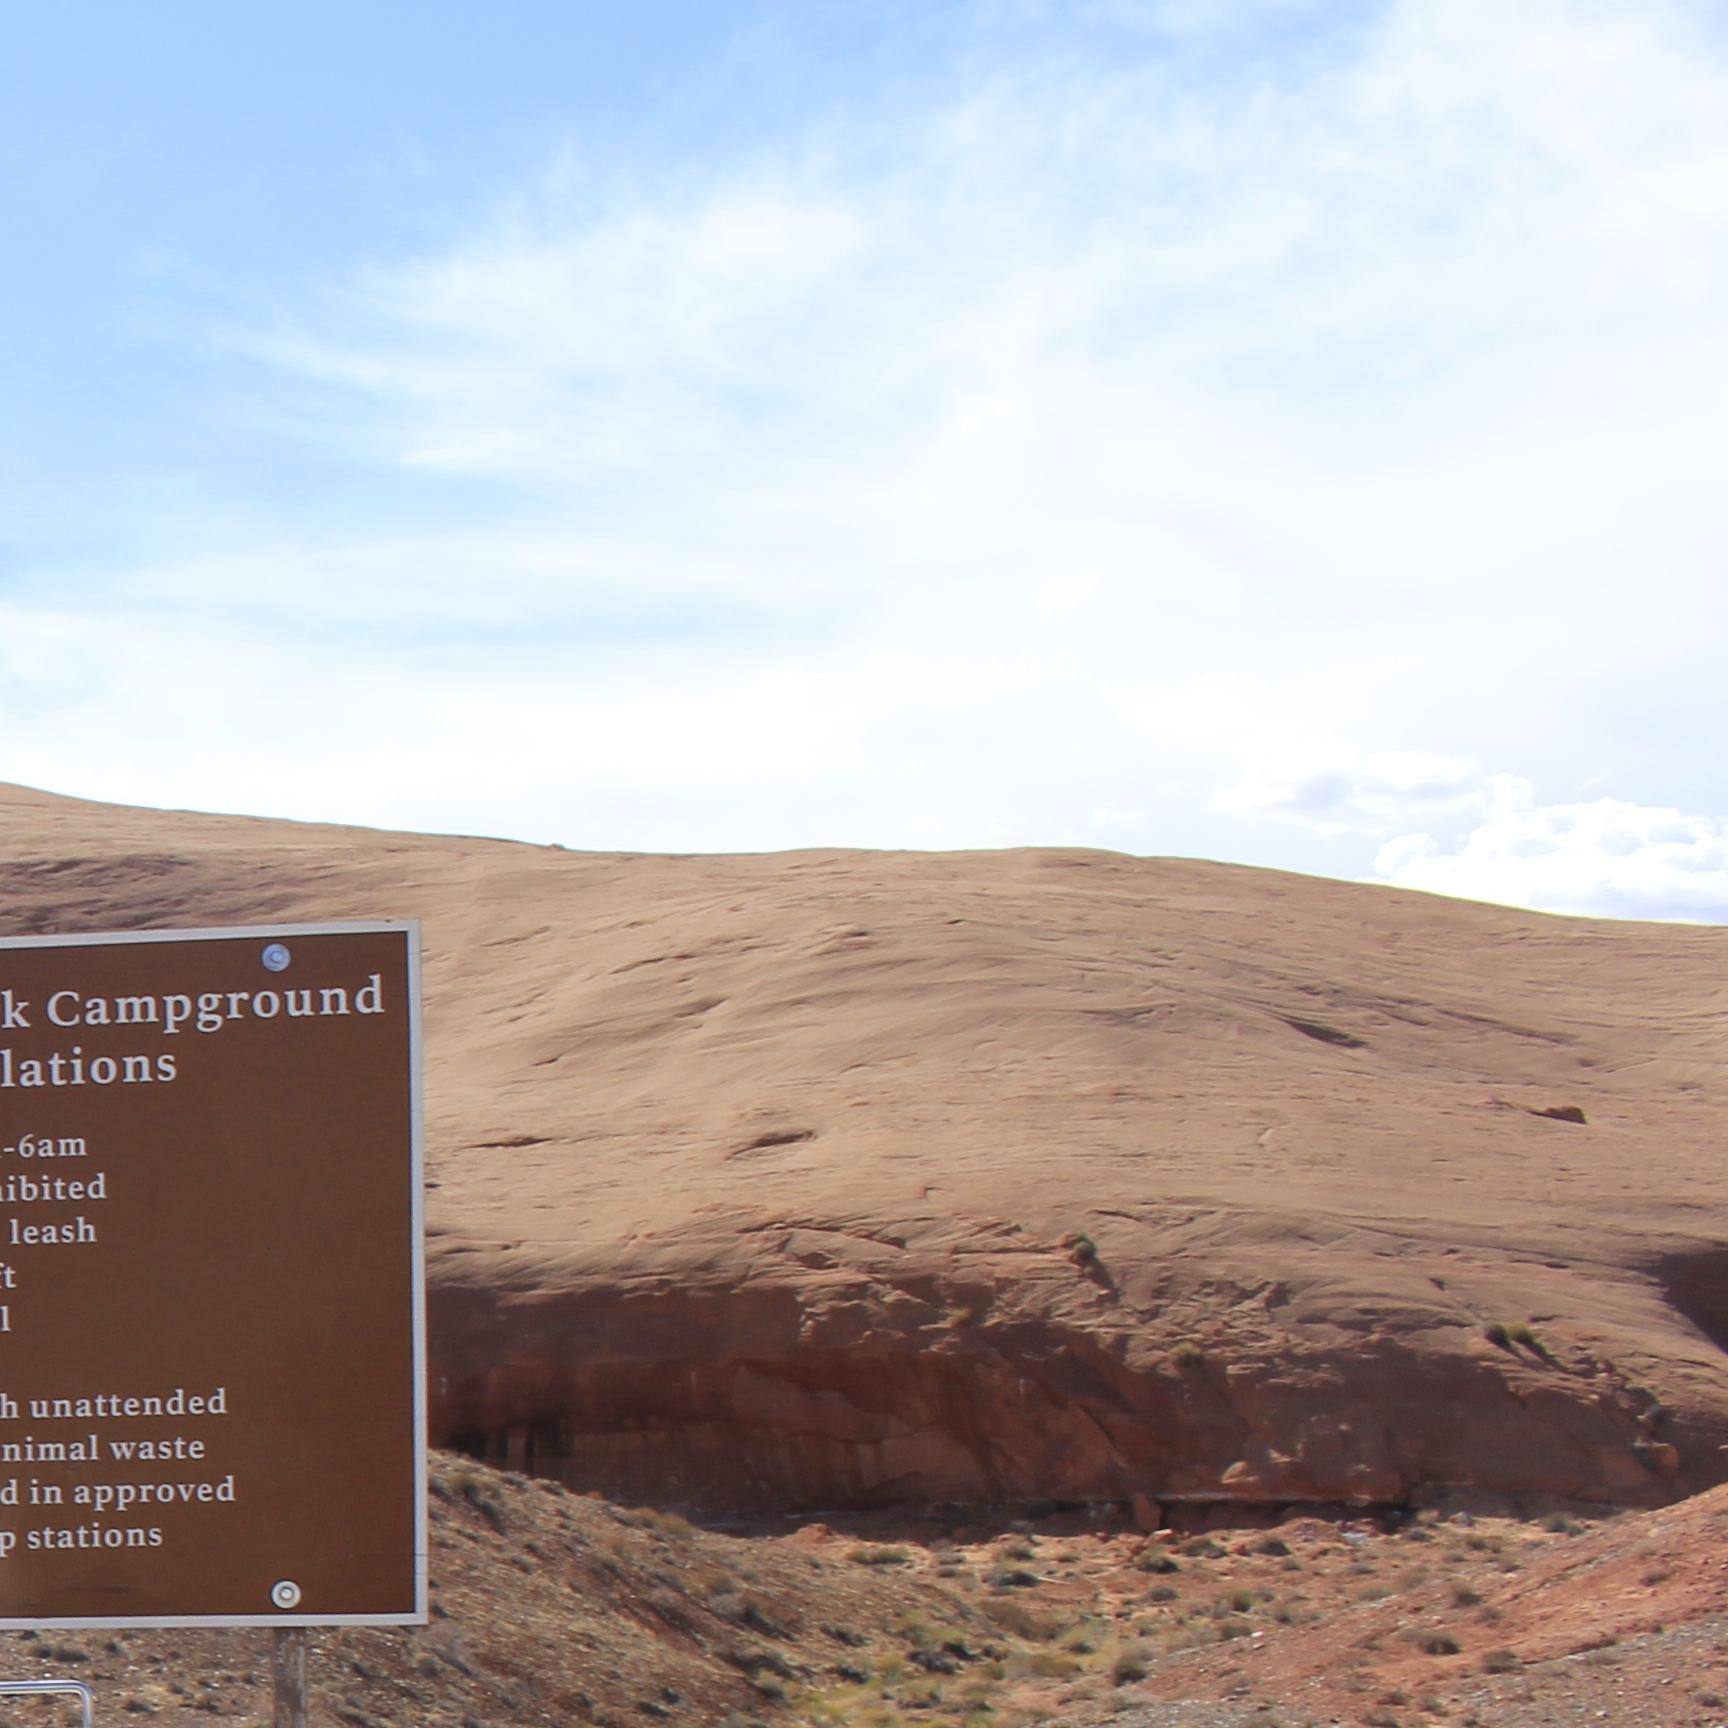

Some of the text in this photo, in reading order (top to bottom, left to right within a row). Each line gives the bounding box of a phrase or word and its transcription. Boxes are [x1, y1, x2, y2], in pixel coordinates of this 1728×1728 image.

[47, 973, 385, 1034] Campground
[9, 1216, 97, 1245] leash
[30, 1387, 227, 1419] unattended
[109, 1437, 205, 1460] waste
[30, 1478, 63, 1505] in
[74, 1474, 236, 1512] approved
[27, 1521, 163, 1550] stations
